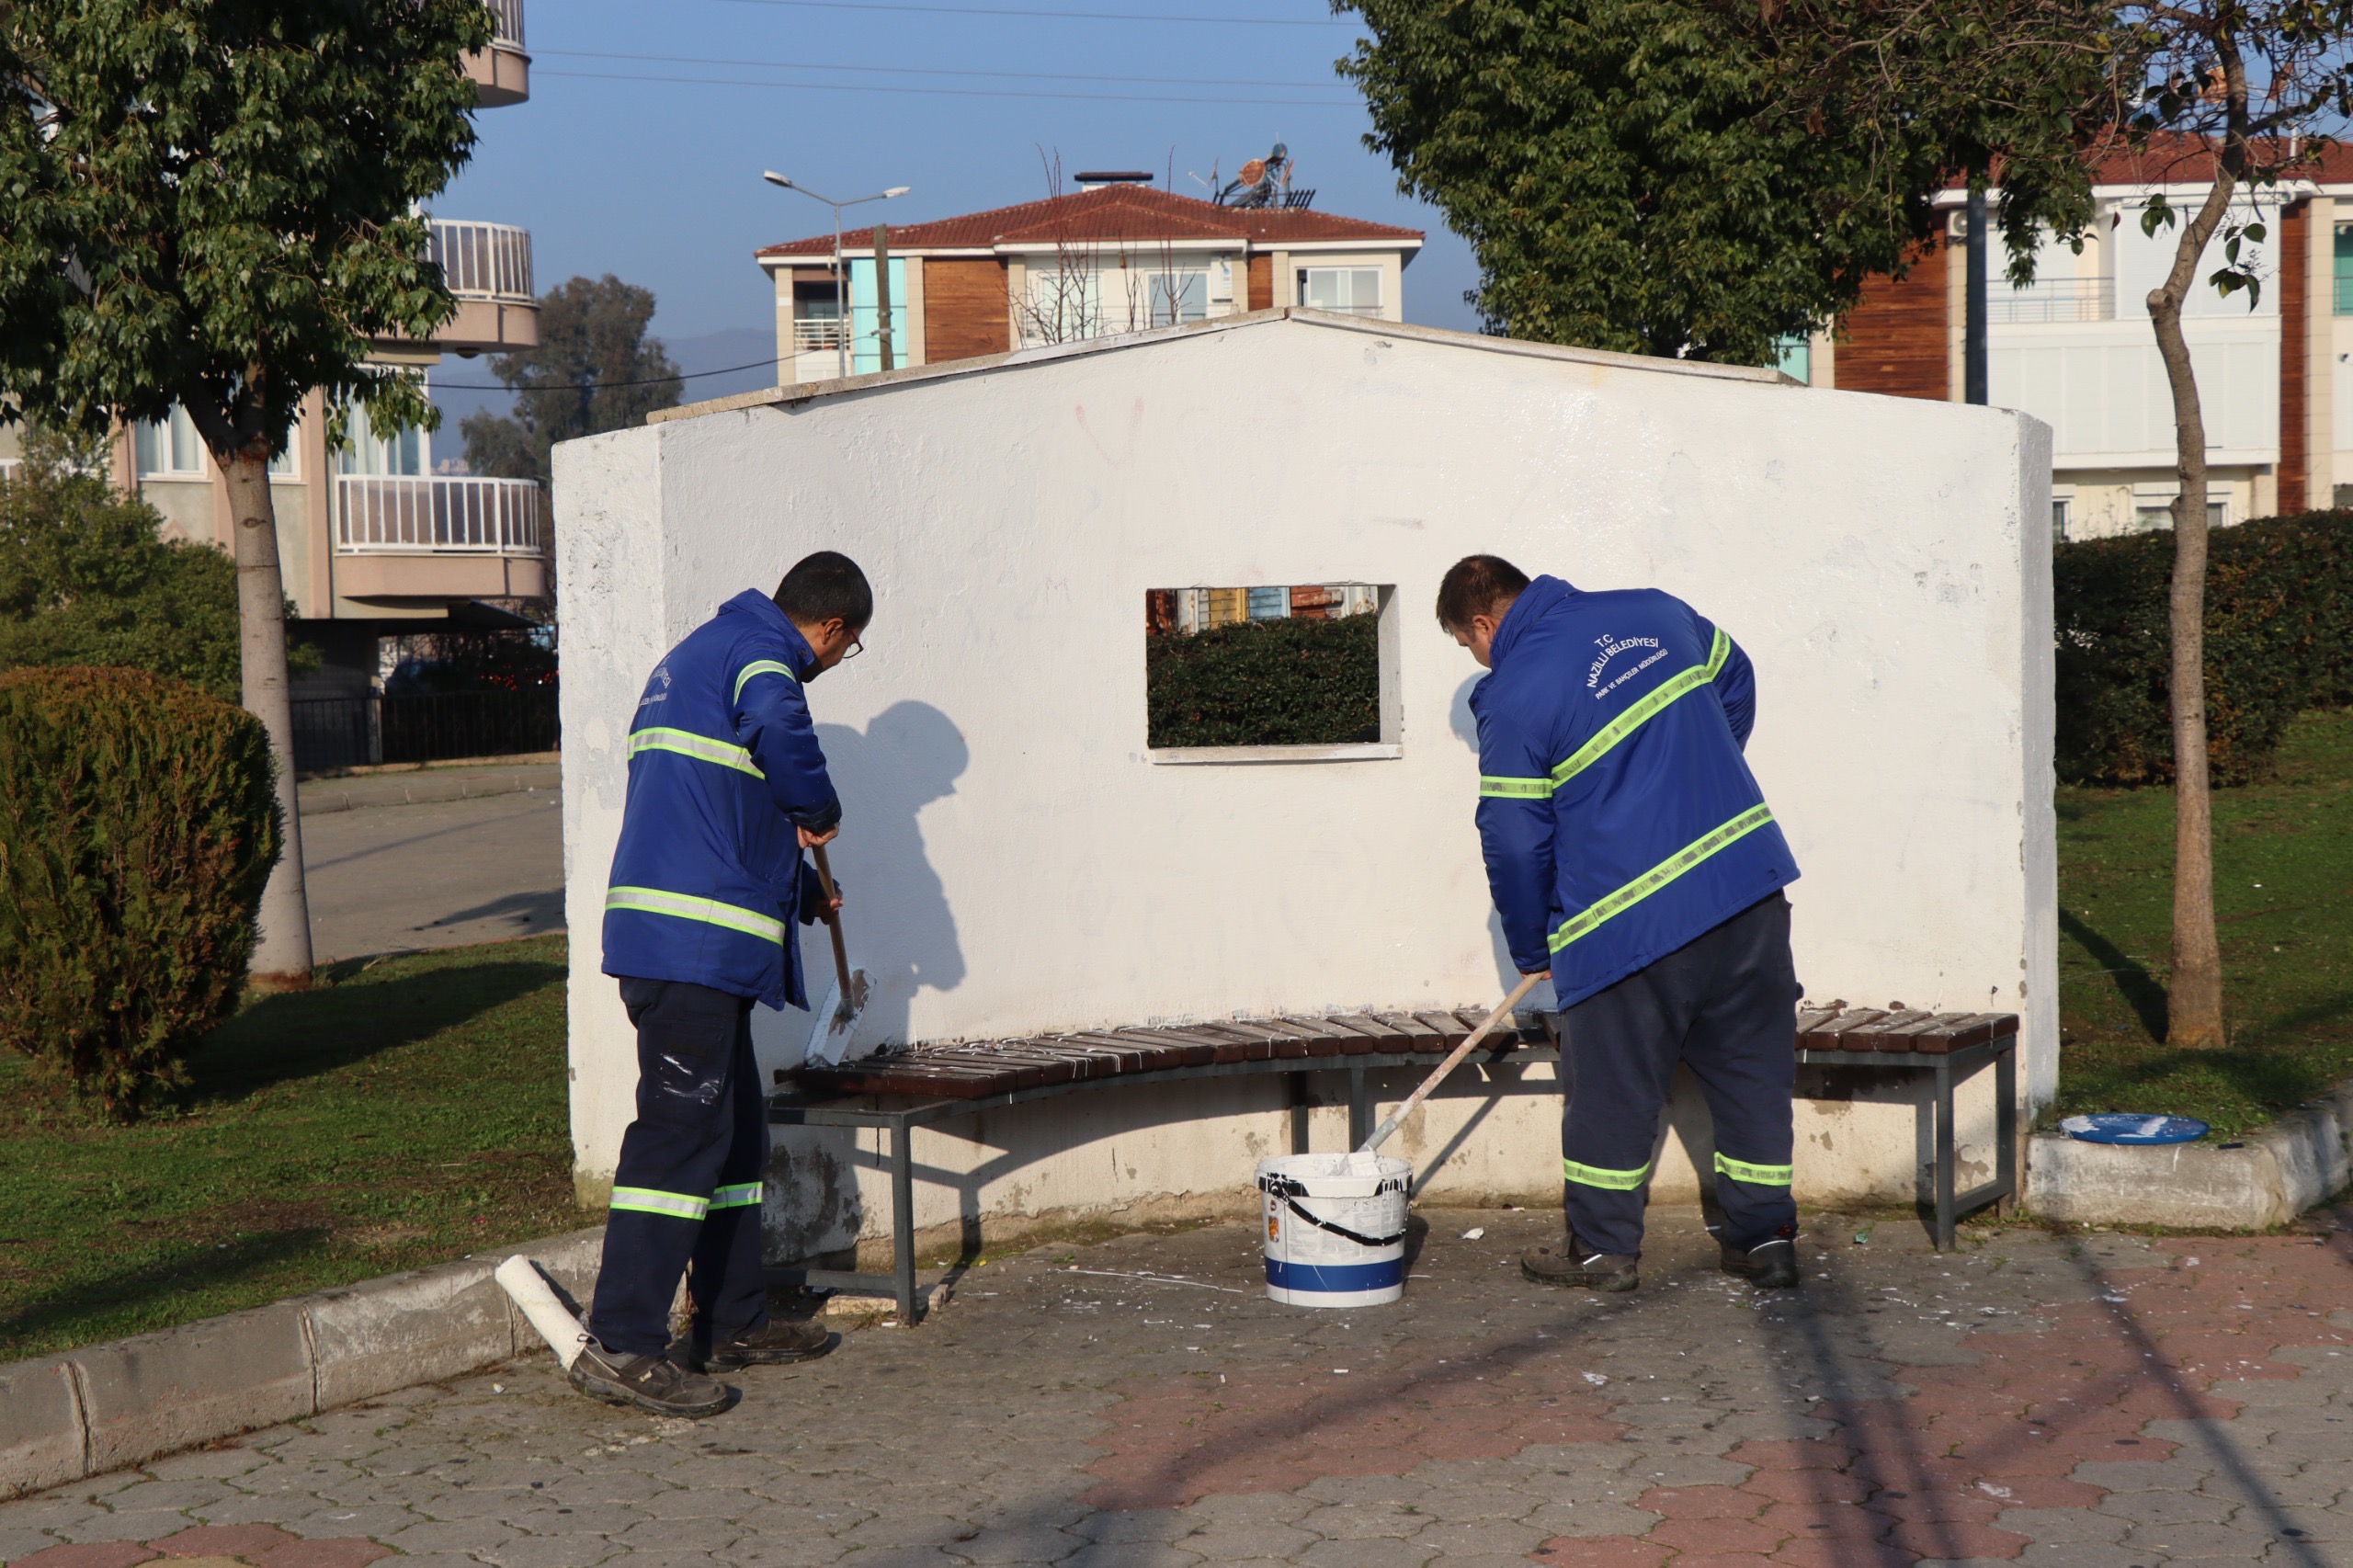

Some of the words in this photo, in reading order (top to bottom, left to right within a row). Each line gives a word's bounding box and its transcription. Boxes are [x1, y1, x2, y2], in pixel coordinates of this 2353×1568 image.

[1594, 634, 1613, 647] T.C
[1586, 652, 1609, 687] NAZİLLİ
[1605, 637, 1658, 656] BELEDİYESİ
[1595, 687, 1609, 699] PARK
[1608, 681, 1618, 689] VE
[1616, 667, 1639, 685] BAHÇELER
